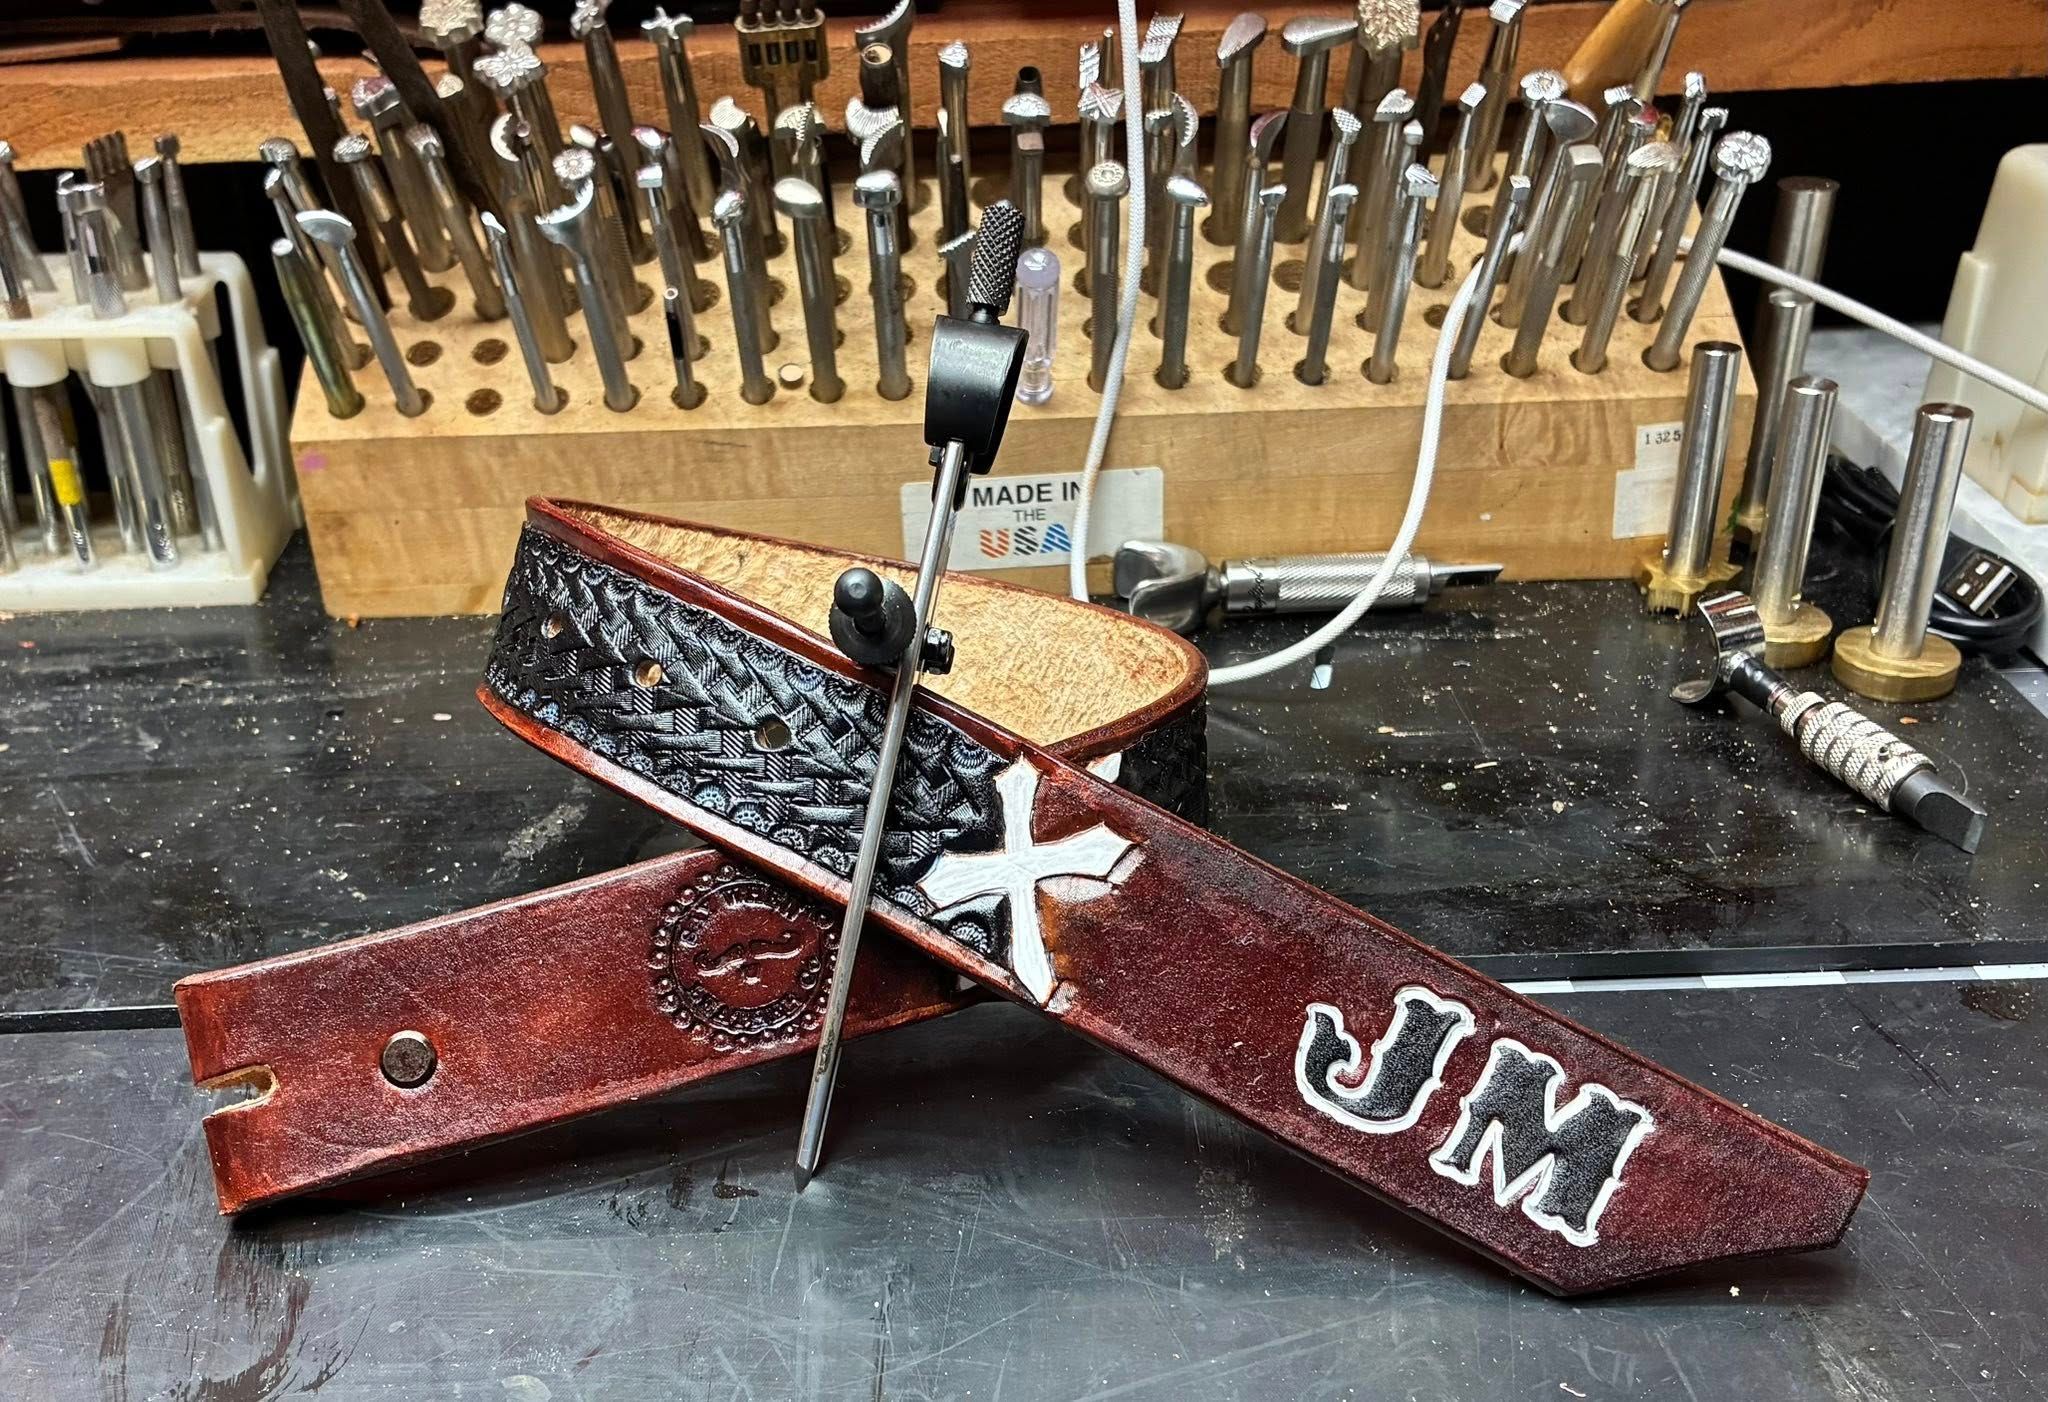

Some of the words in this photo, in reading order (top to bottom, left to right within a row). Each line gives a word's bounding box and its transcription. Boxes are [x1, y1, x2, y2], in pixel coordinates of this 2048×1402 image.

[973, 482, 1053, 507] MADE
[1013, 509, 1047, 522] THE
[979, 523, 1072, 558] USA
[1295, 985, 1656, 1248] JM
